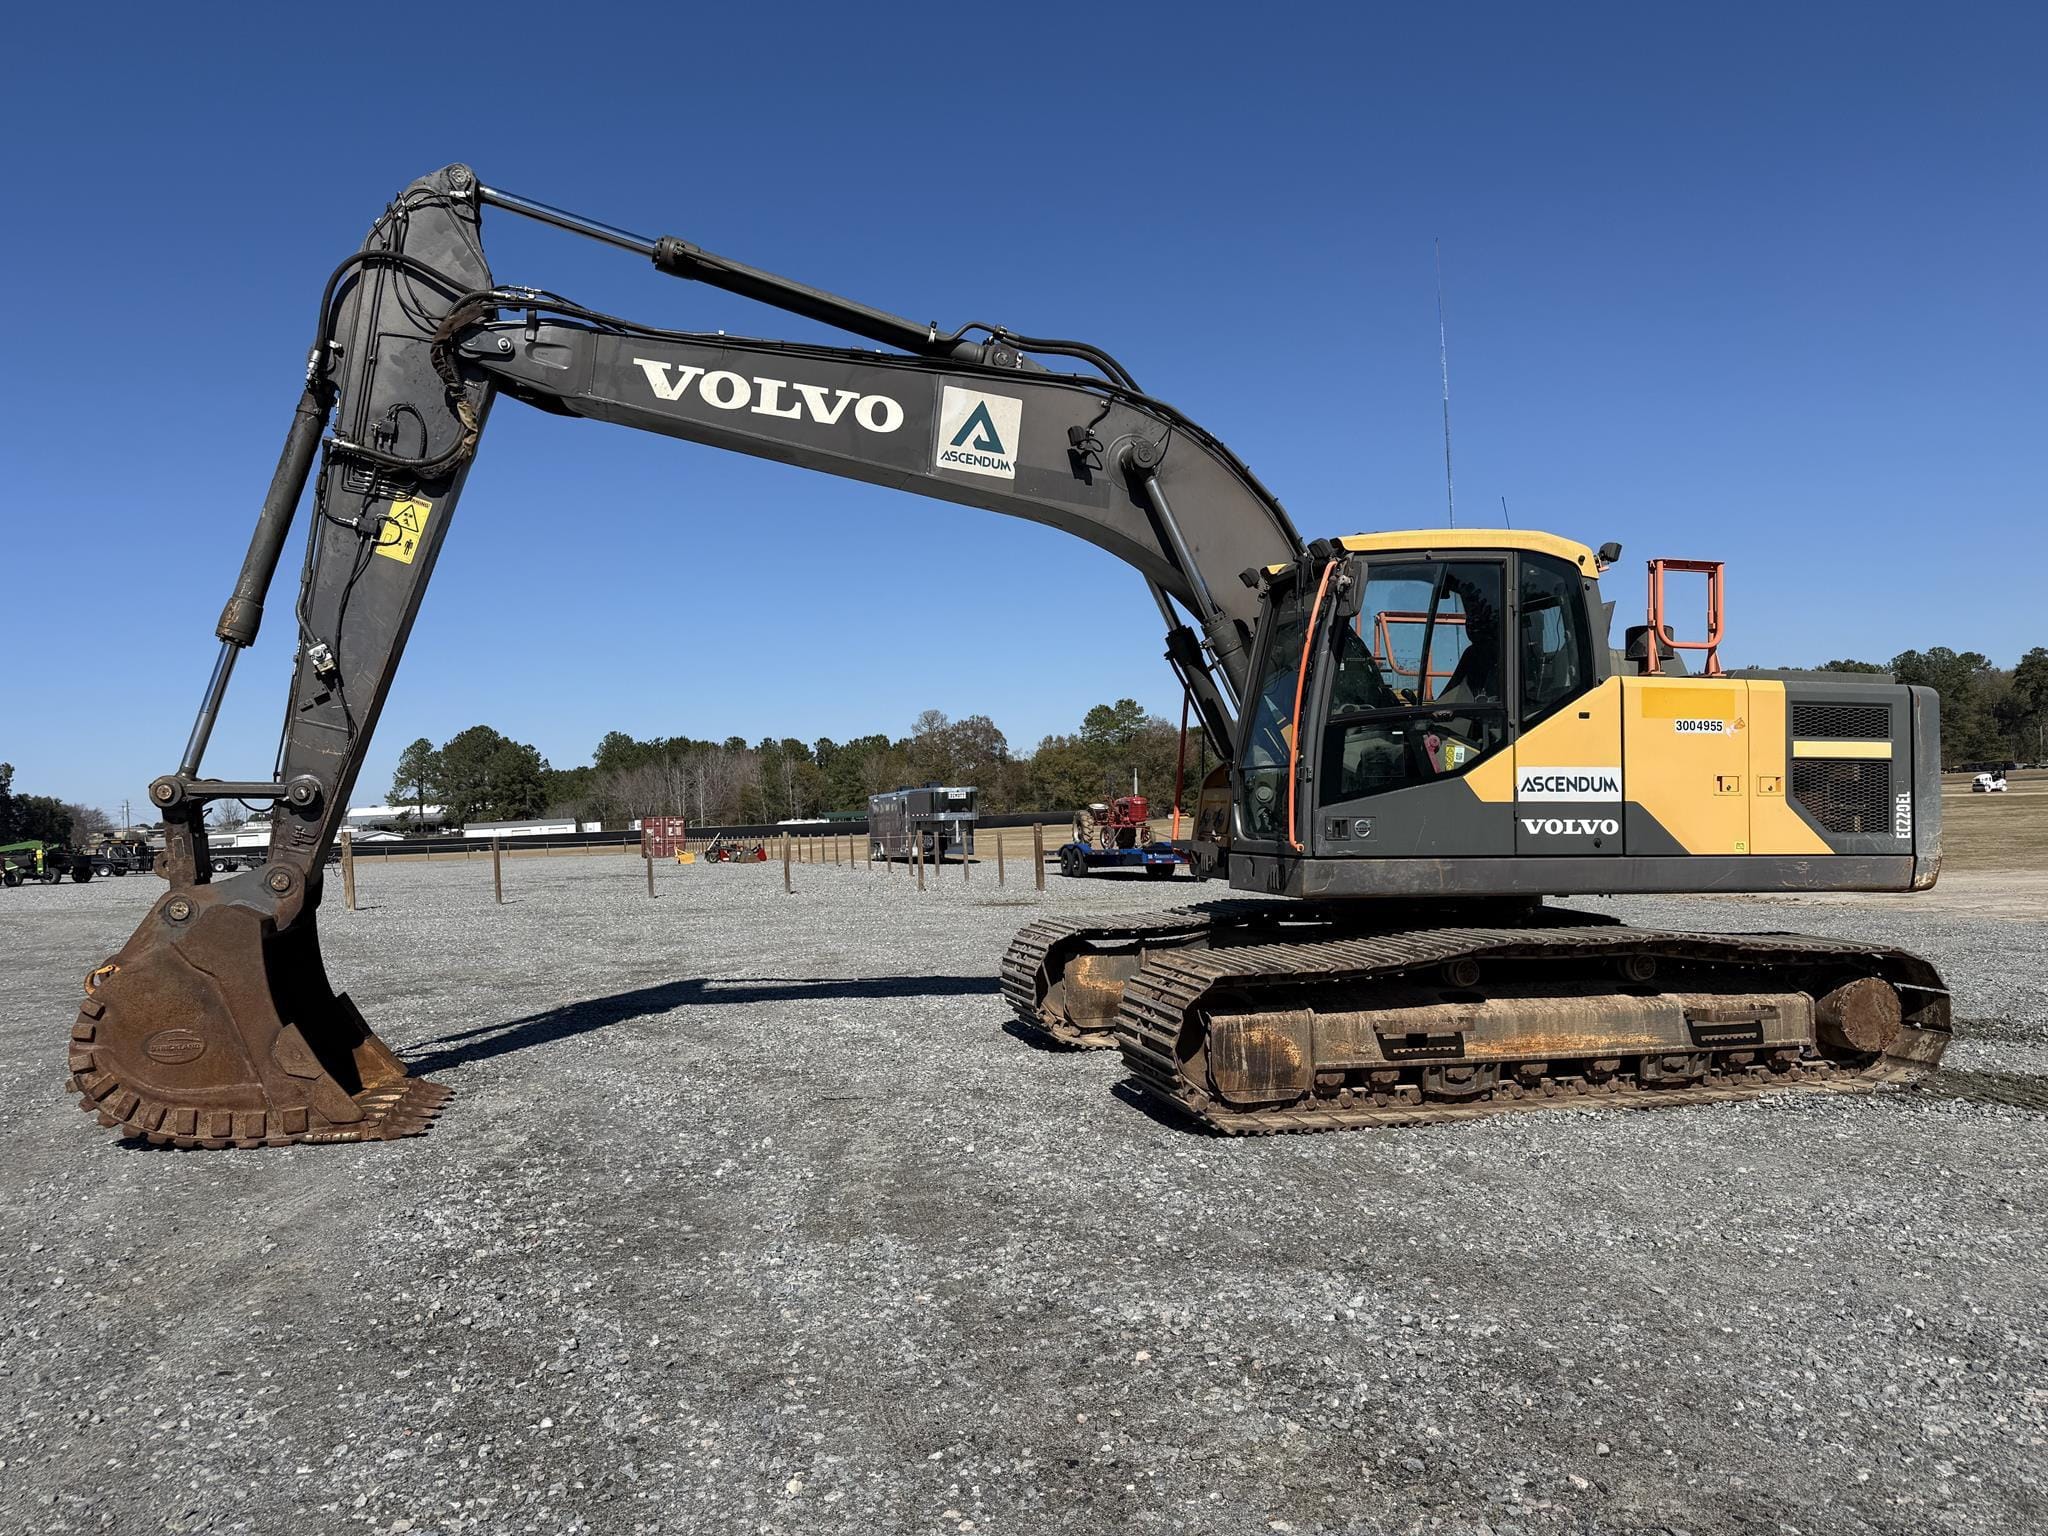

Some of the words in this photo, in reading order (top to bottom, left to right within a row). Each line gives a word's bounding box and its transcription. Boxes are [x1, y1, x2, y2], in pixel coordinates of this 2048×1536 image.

[633, 358, 905, 433] VOLVO
[940, 450, 1012, 472] ASCENDUM
[1676, 720, 1723, 731] 3004955
[1520, 776, 1619, 792] ASCENDUM
[1895, 791, 1911, 839] EC220EL
[1520, 818, 1619, 835] VOLVO
